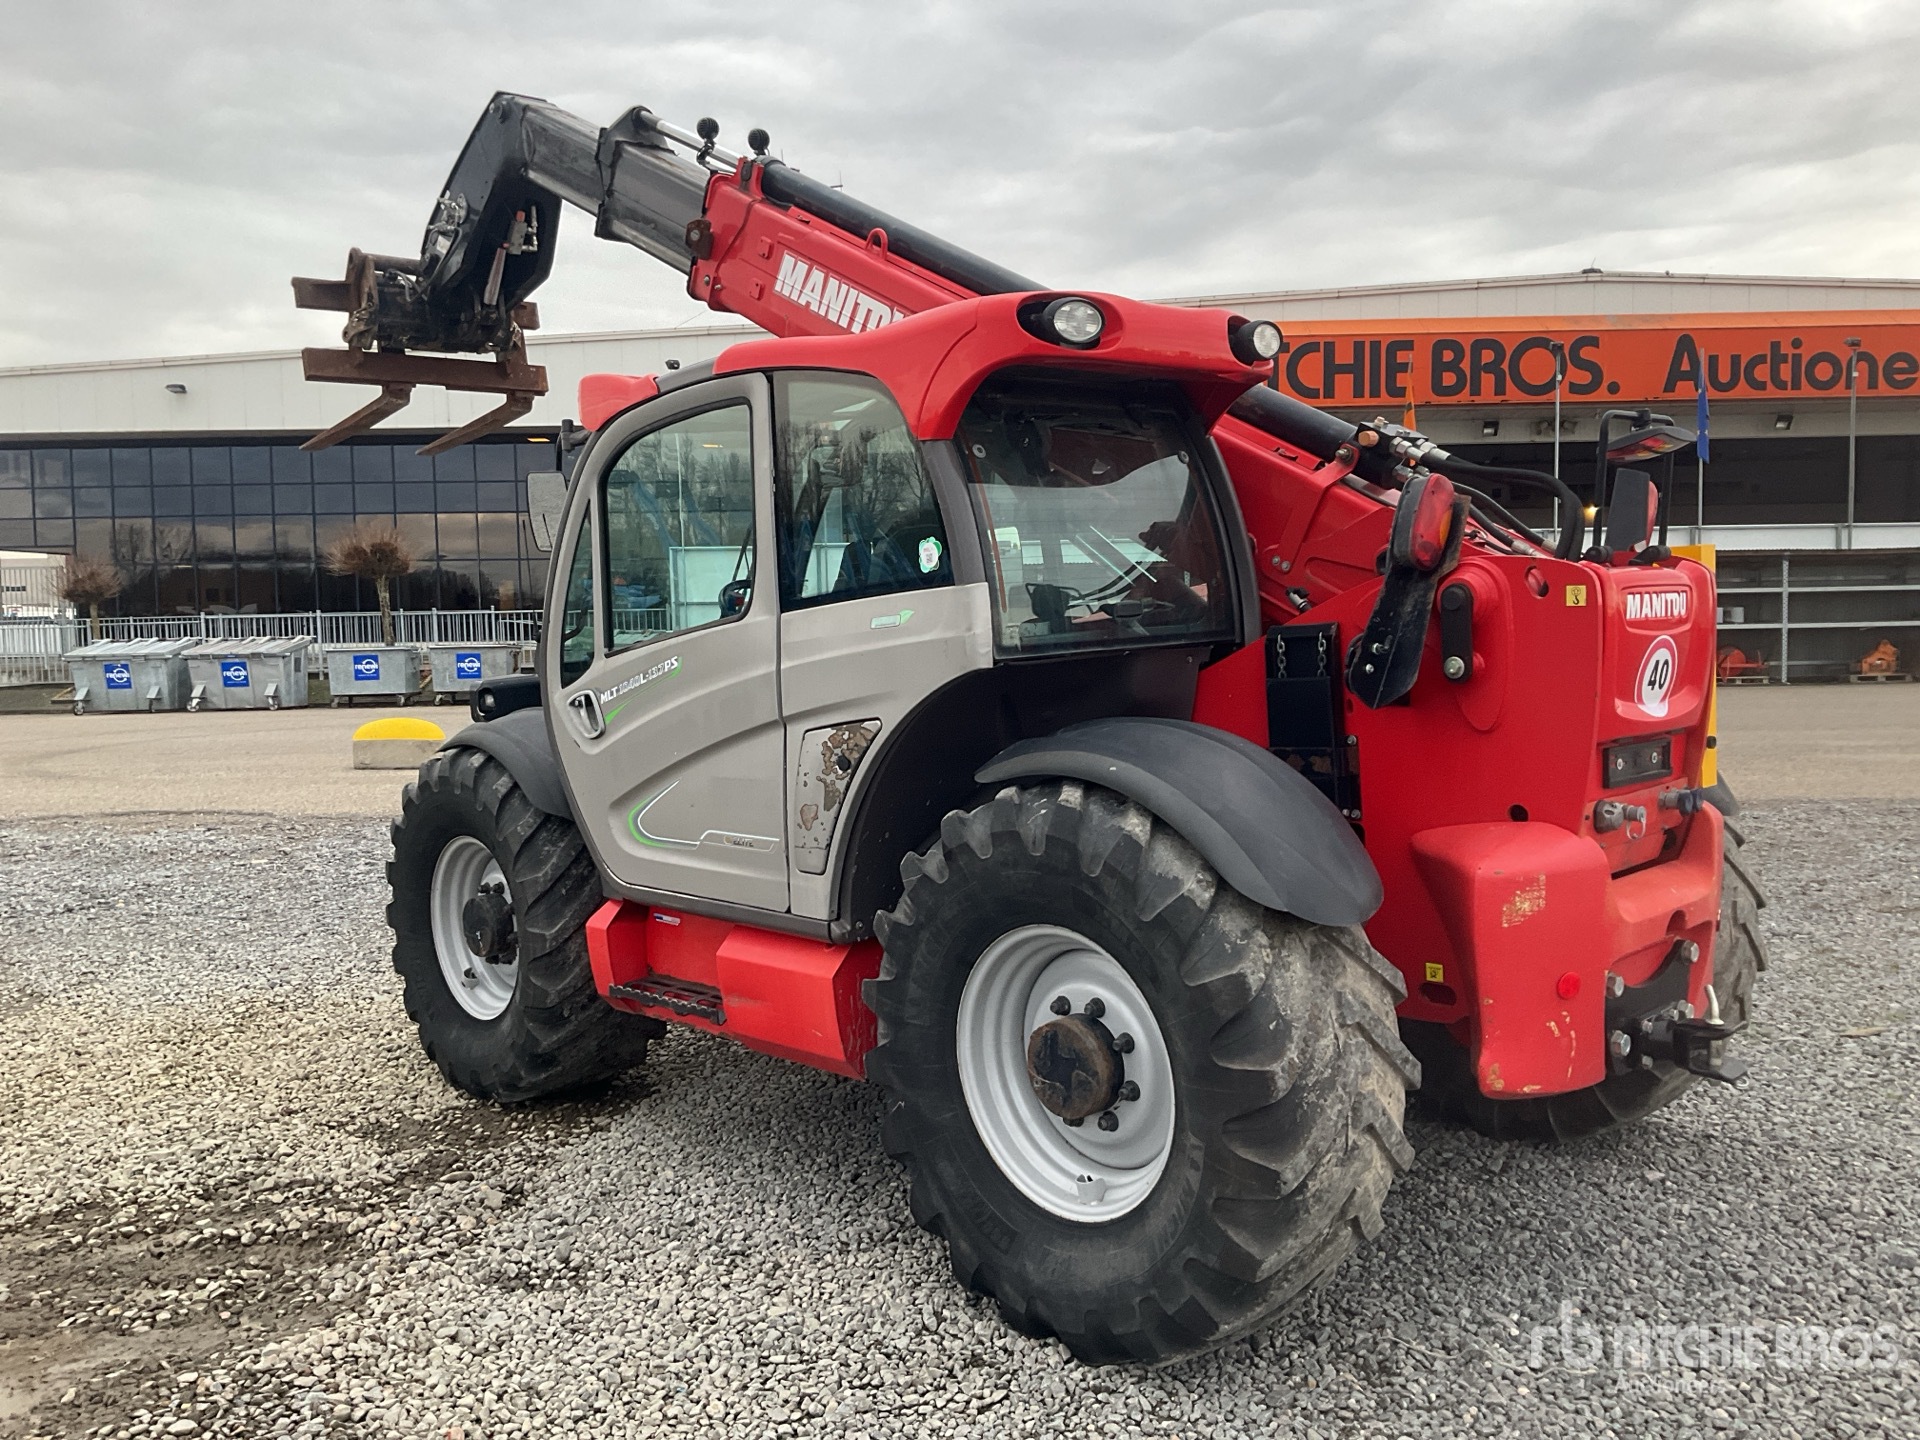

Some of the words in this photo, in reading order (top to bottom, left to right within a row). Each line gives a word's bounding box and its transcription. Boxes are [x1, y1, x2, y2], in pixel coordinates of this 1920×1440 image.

[774, 253, 905, 334] MANITO
[1431, 335, 1621, 397] BROS.
[1662, 333, 1919, 394] Auctione
[1626, 591, 1687, 620] MANITOU
[1647, 658, 1670, 691] 40
[600, 686, 618, 705] MLT
